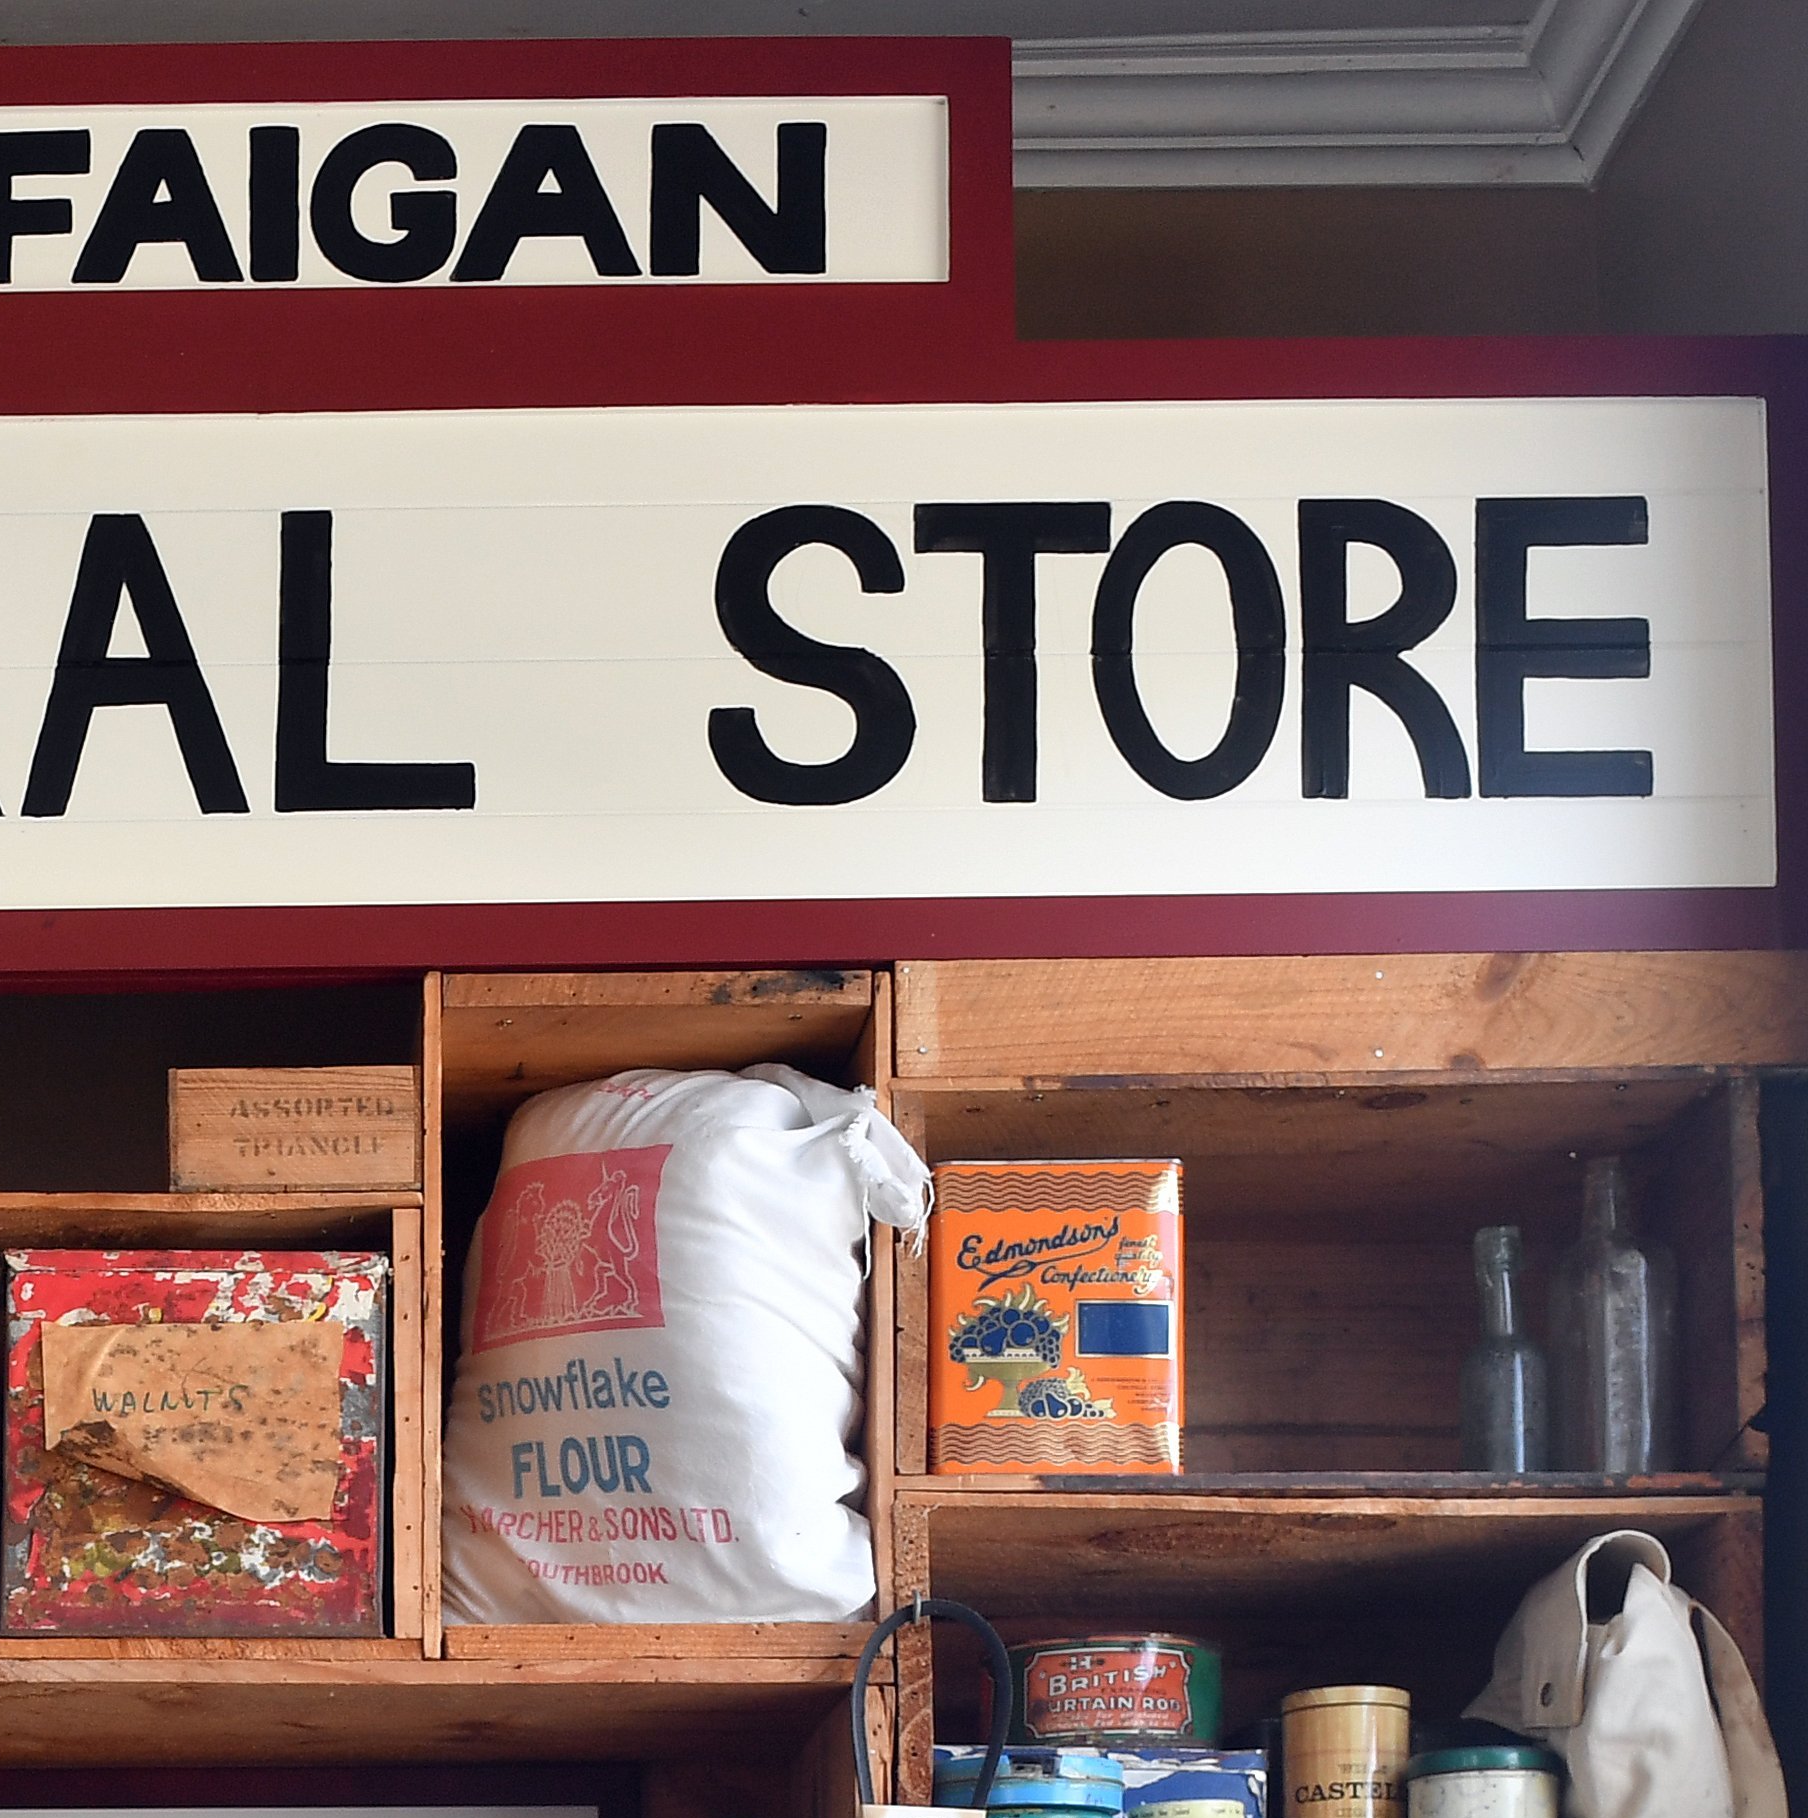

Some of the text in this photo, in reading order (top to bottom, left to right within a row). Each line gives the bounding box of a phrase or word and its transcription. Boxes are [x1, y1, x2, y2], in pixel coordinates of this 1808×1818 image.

[706, 496, 1654, 808] STORE
[230, 1096, 394, 1119] ASSORTED
[233, 1134, 386, 1158] TRIANGLE
[91, 1384, 250, 1418] WALNUTS
[477, 1356, 672, 1423] snowflake
[510, 1433, 654, 1499] FLOUR
[604, 1507, 677, 1543] SONS
[522, 1560, 670, 1586] OUTHBROOK
[1048, 1664, 1168, 1698] BRITISH
[1045, 1696, 1133, 1713] URTAIN
